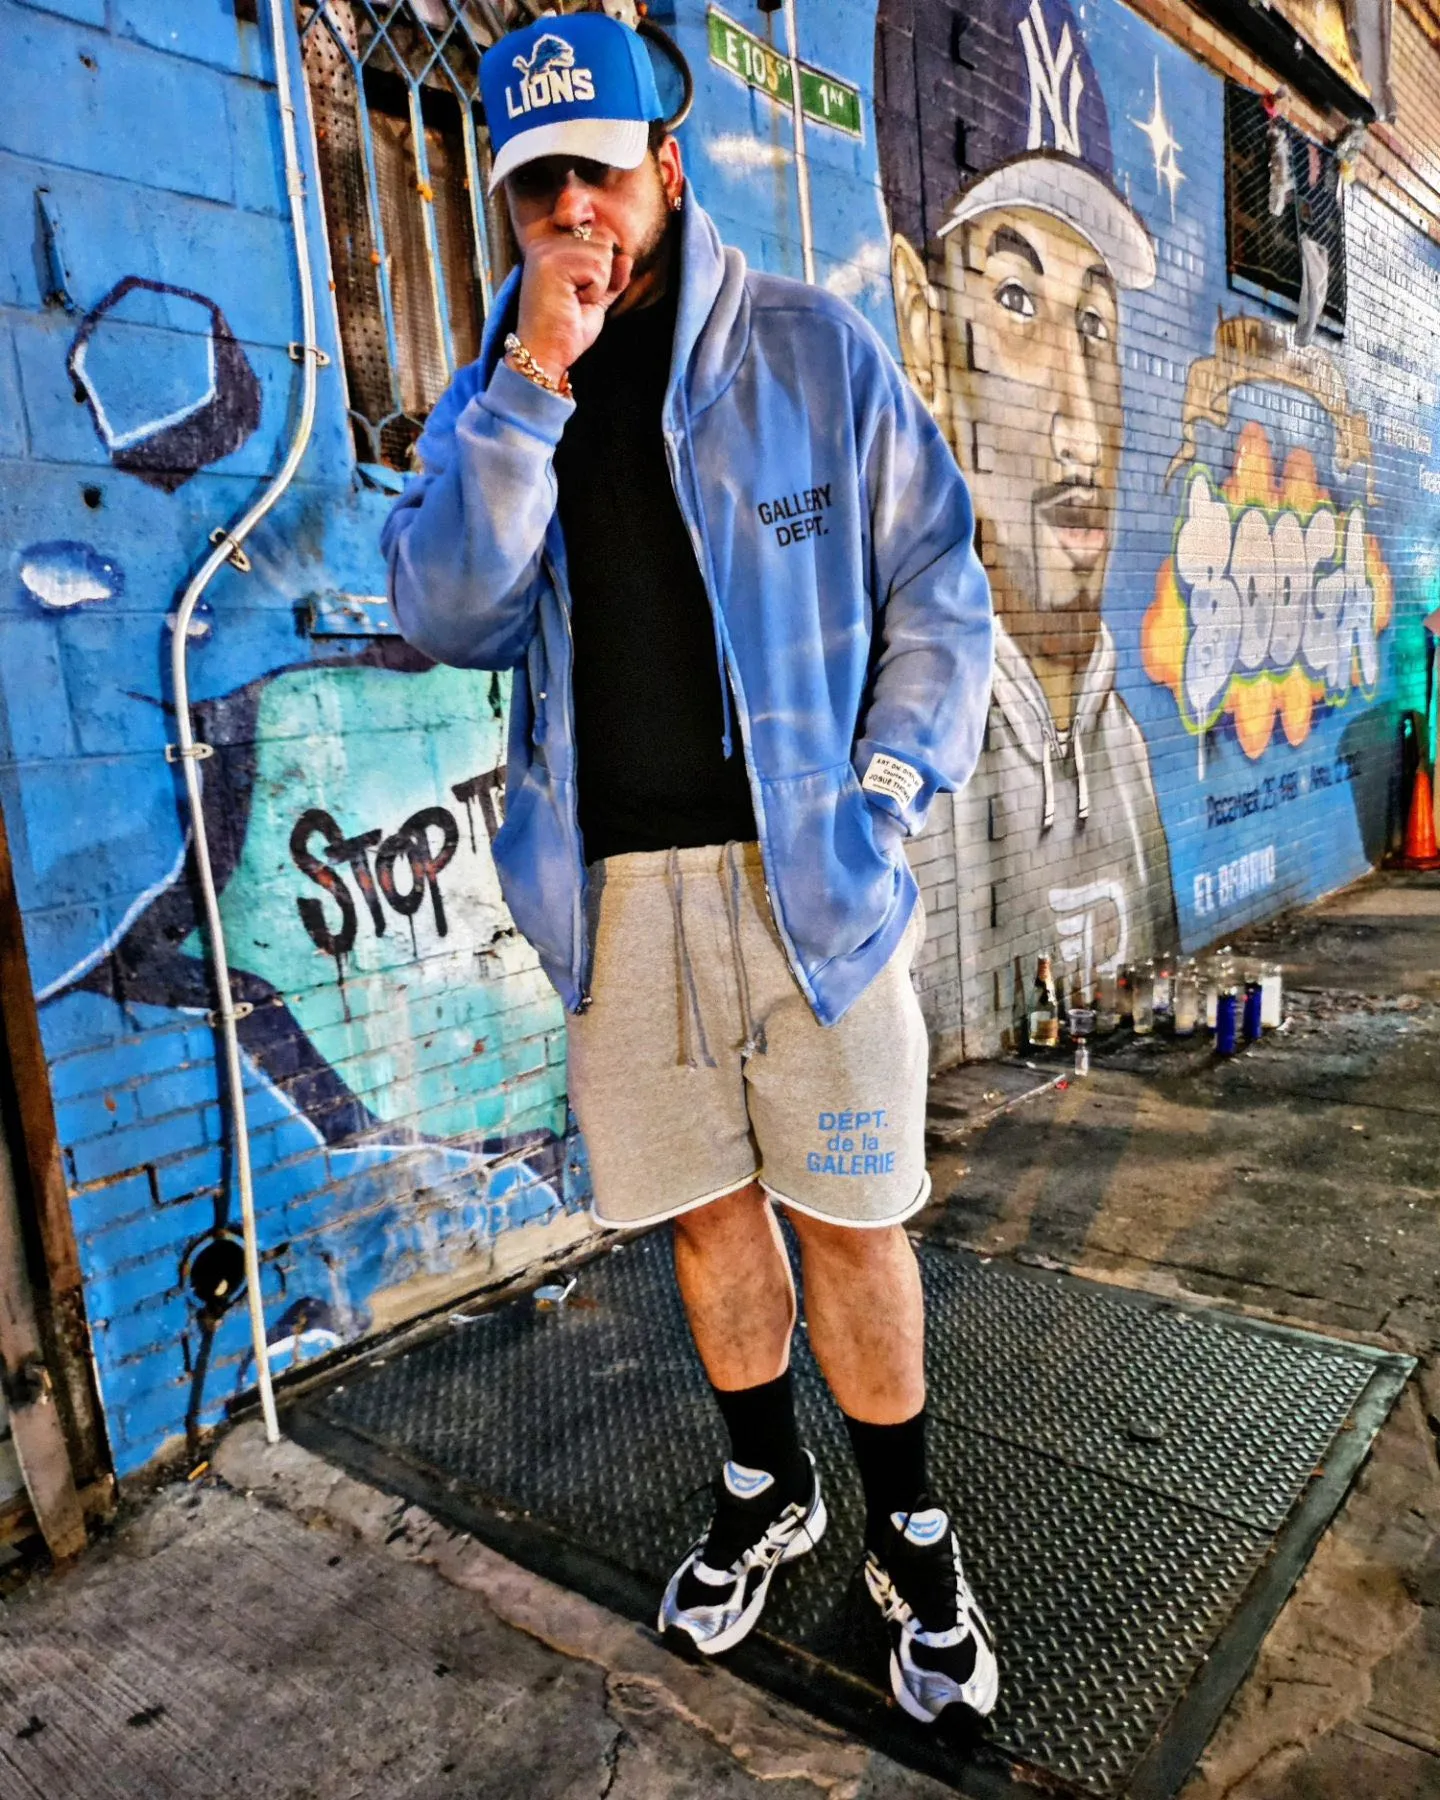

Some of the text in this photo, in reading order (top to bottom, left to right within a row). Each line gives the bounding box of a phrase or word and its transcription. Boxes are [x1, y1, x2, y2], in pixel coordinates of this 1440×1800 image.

[724, 30, 739, 67] E
[505, 68, 595, 119] LIONS
[757, 483, 832, 525] GALLERY
[775, 515, 829, 547] DEPT.
[289, 805, 459, 956] STOP
[818, 1106, 889, 1131] DÉPT.
[827, 1132, 879, 1152] de la
[806, 1150, 895, 1176] GALERIE
